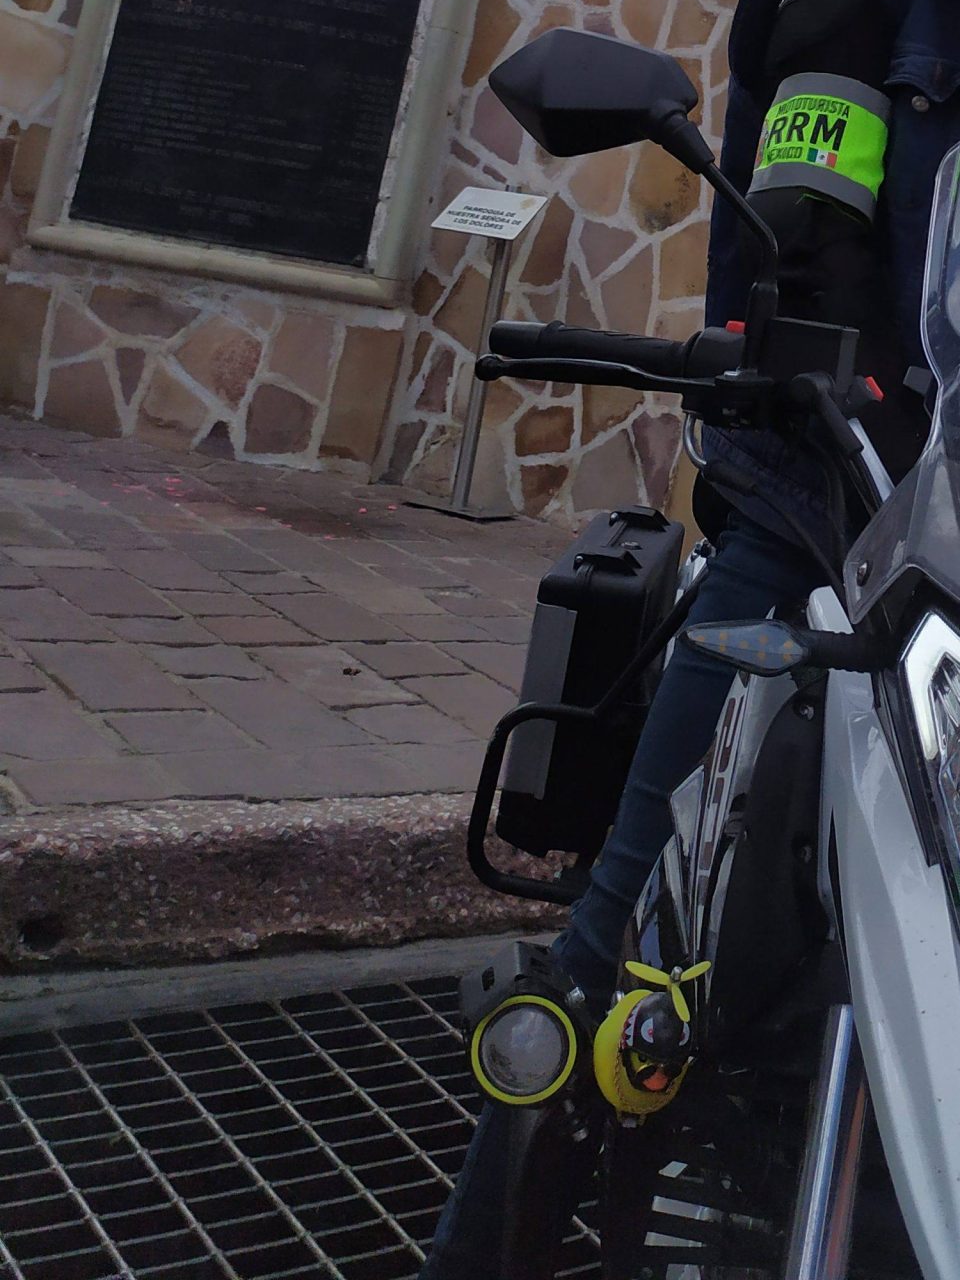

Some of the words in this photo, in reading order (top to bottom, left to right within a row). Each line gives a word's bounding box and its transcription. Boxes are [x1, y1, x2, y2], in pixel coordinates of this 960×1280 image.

[767, 111, 848, 151] RRM
[447, 210, 480, 219] NUESTRA
[480, 214, 510, 224] SEÑORA
[463, 205, 504, 216] PARROQUIA
[453, 217, 467, 225] LOS
[468, 219, 504, 230] DOLORES
